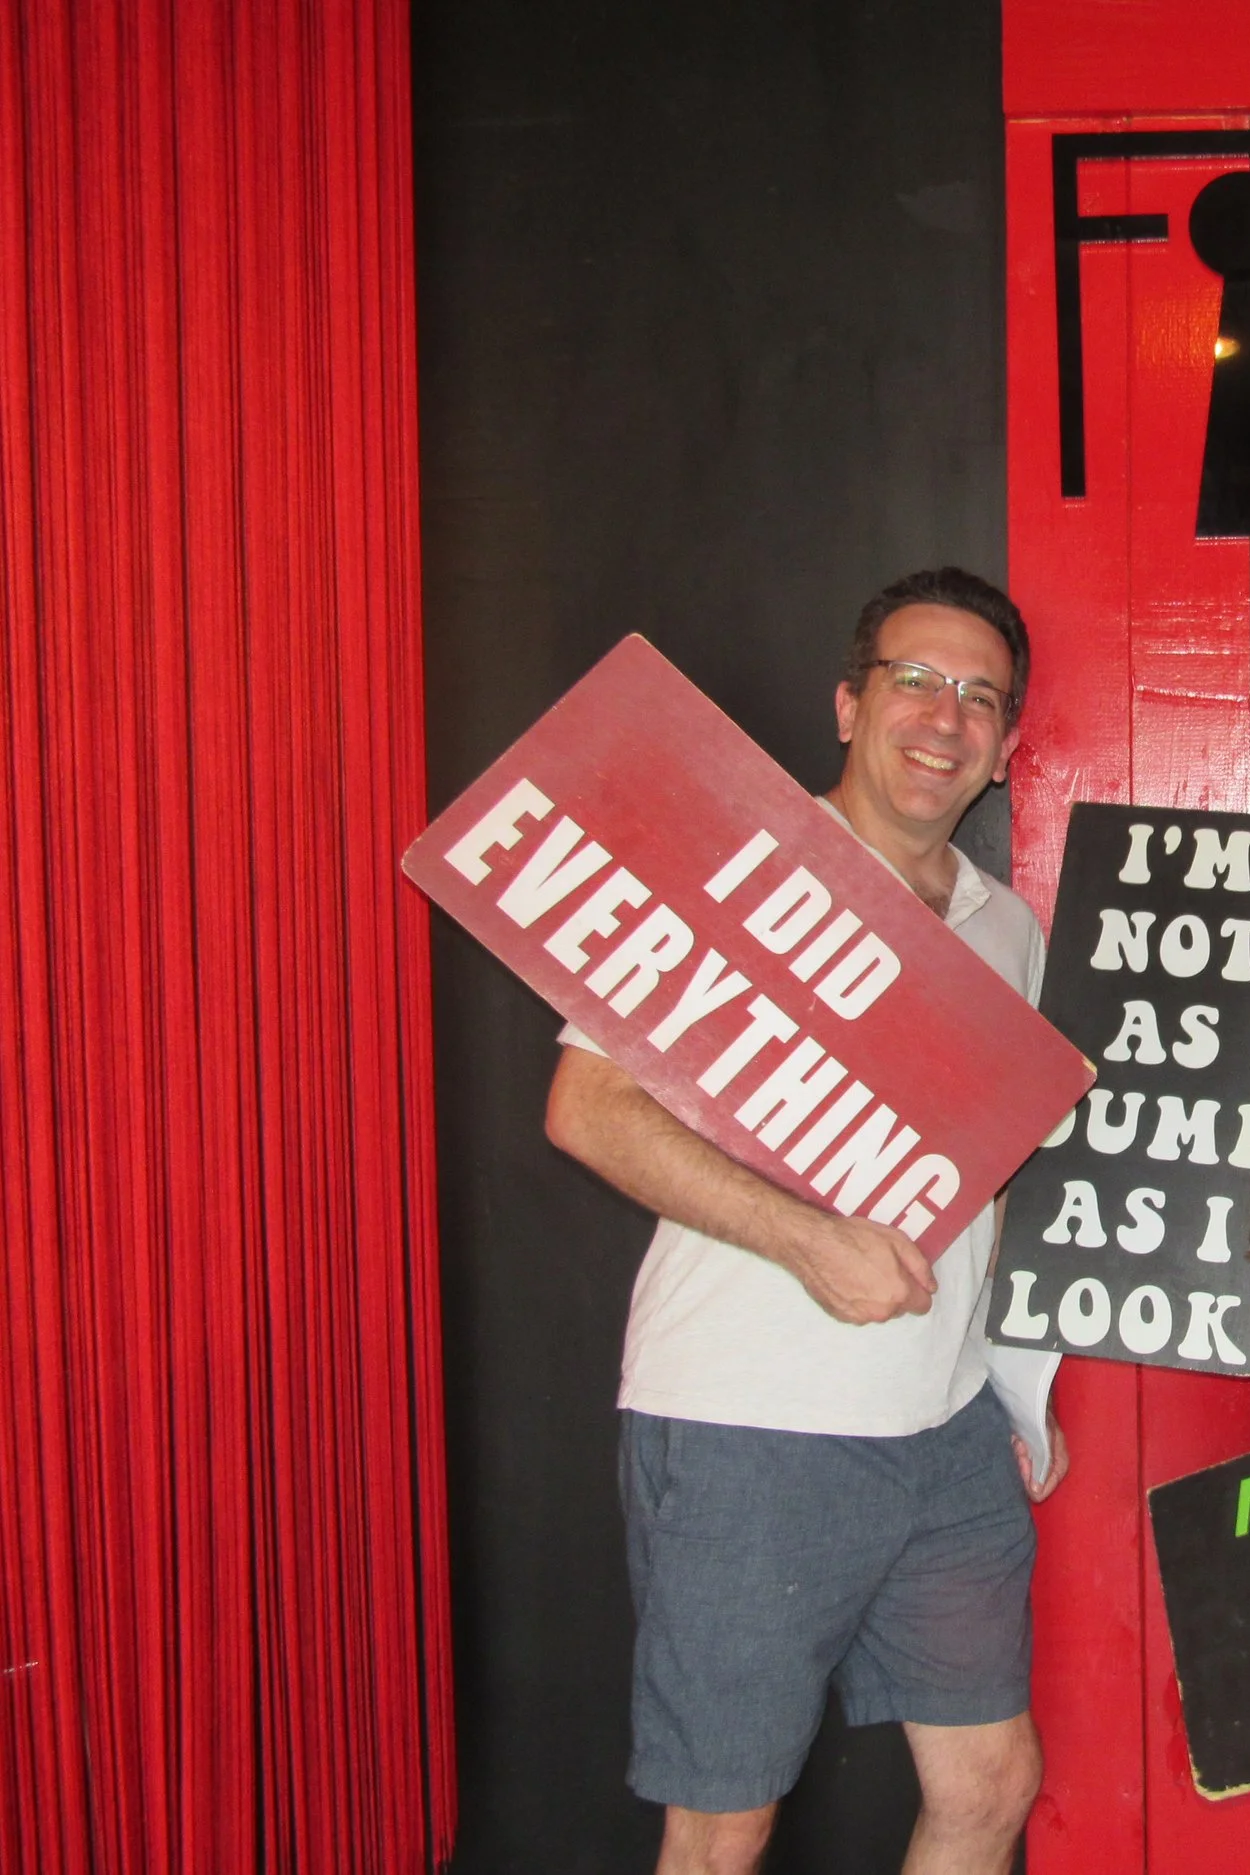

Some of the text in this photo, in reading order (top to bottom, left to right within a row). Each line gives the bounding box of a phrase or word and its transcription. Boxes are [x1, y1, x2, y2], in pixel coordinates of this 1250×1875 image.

[702, 828, 902, 1021] I DID
[443, 777, 961, 1243] EVERYTHING
[1103, 1000, 1220, 1069] AS
[1042, 1180, 1233, 1263] AS I
[1000, 1270, 1247, 1365] LOOK
